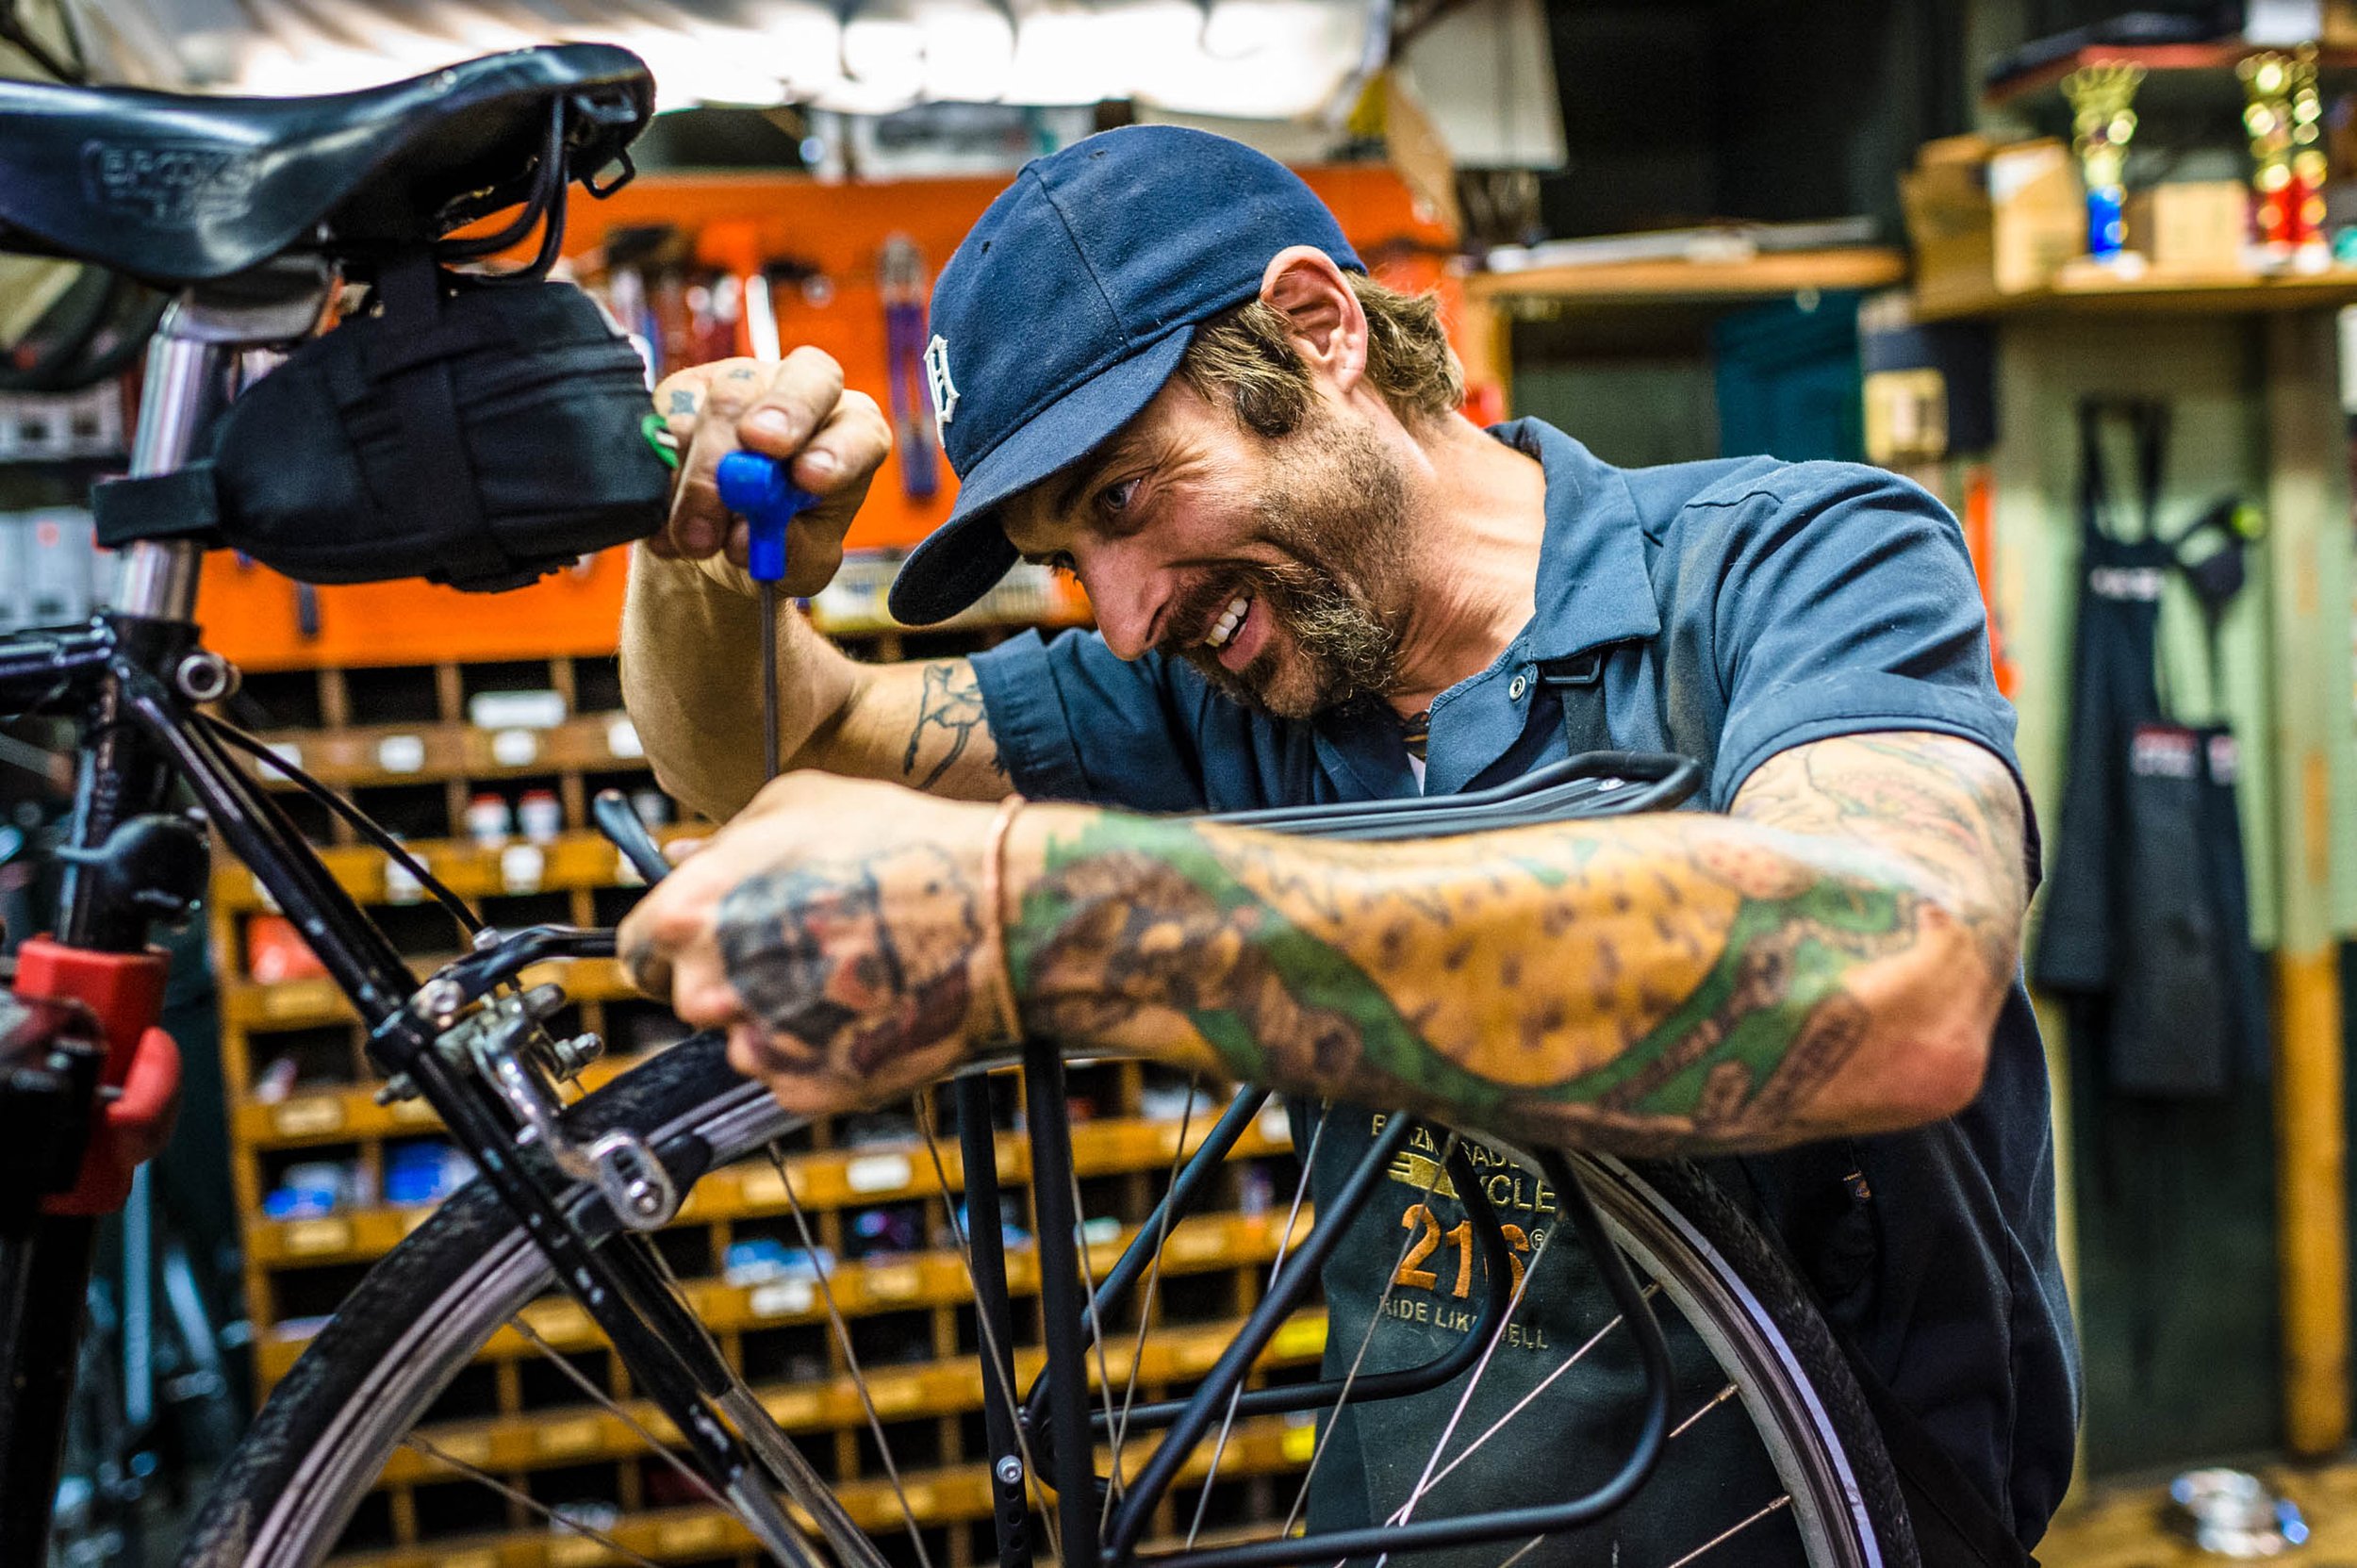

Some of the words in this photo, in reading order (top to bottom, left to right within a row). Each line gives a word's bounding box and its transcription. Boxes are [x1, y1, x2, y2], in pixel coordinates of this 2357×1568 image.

[1479, 1174, 1556, 1213] CLE
[1379, 1296, 1428, 1323] RIDE
[1434, 1307, 1477, 1332] LIK
[1502, 1323, 1549, 1350] ELL
